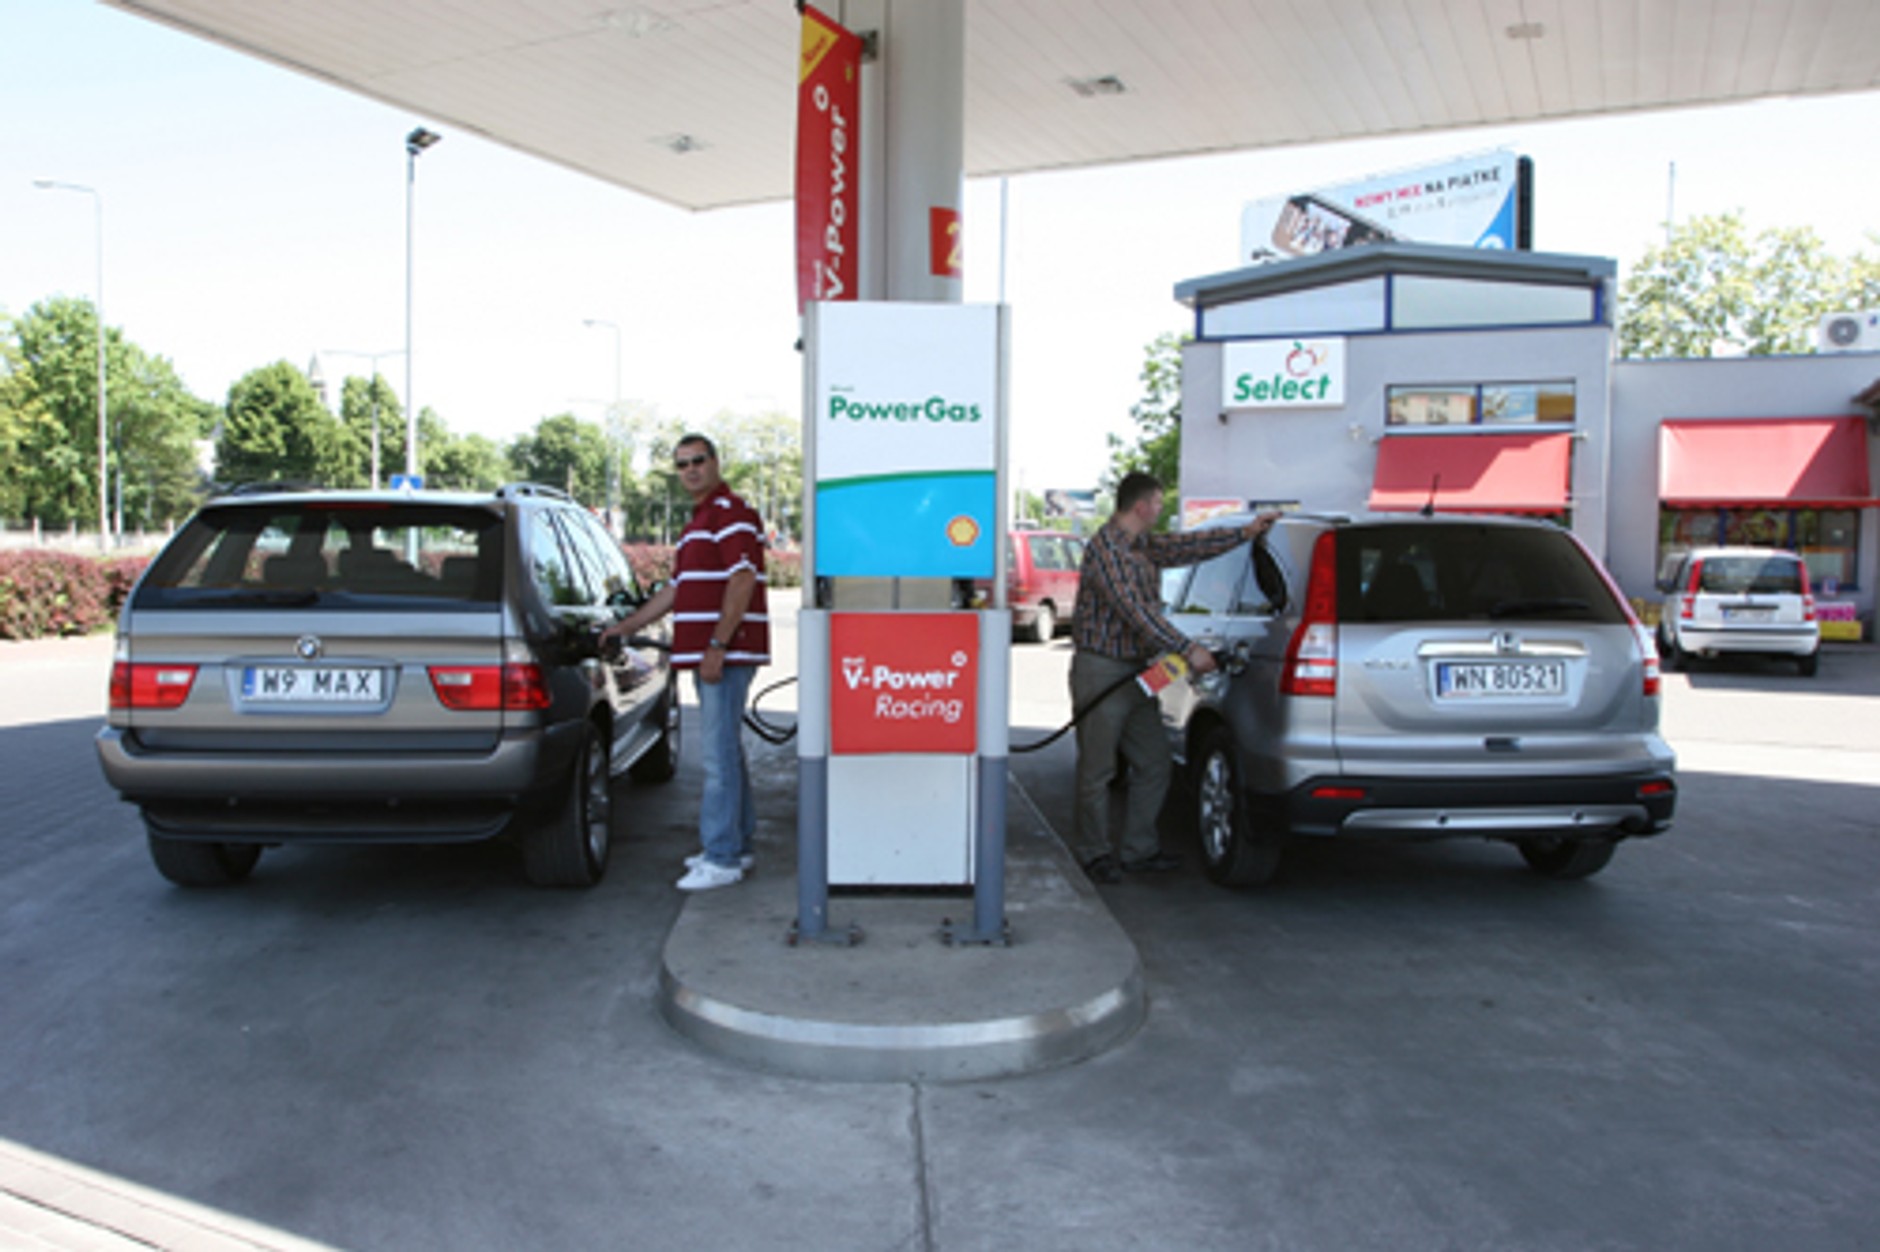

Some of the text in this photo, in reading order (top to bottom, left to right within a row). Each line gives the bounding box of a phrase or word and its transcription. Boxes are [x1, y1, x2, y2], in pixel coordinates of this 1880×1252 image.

[1425, 180, 1444, 194] NA
[825, 104, 847, 299] V-Power
[1233, 373, 1331, 401] Select
[829, 395, 982, 422] PowerGas
[263, 669, 371, 693] W9 MAX
[842, 665, 959, 690] V-Power
[1453, 668, 1558, 689] WN 80521
[875, 693, 963, 723] Racing
